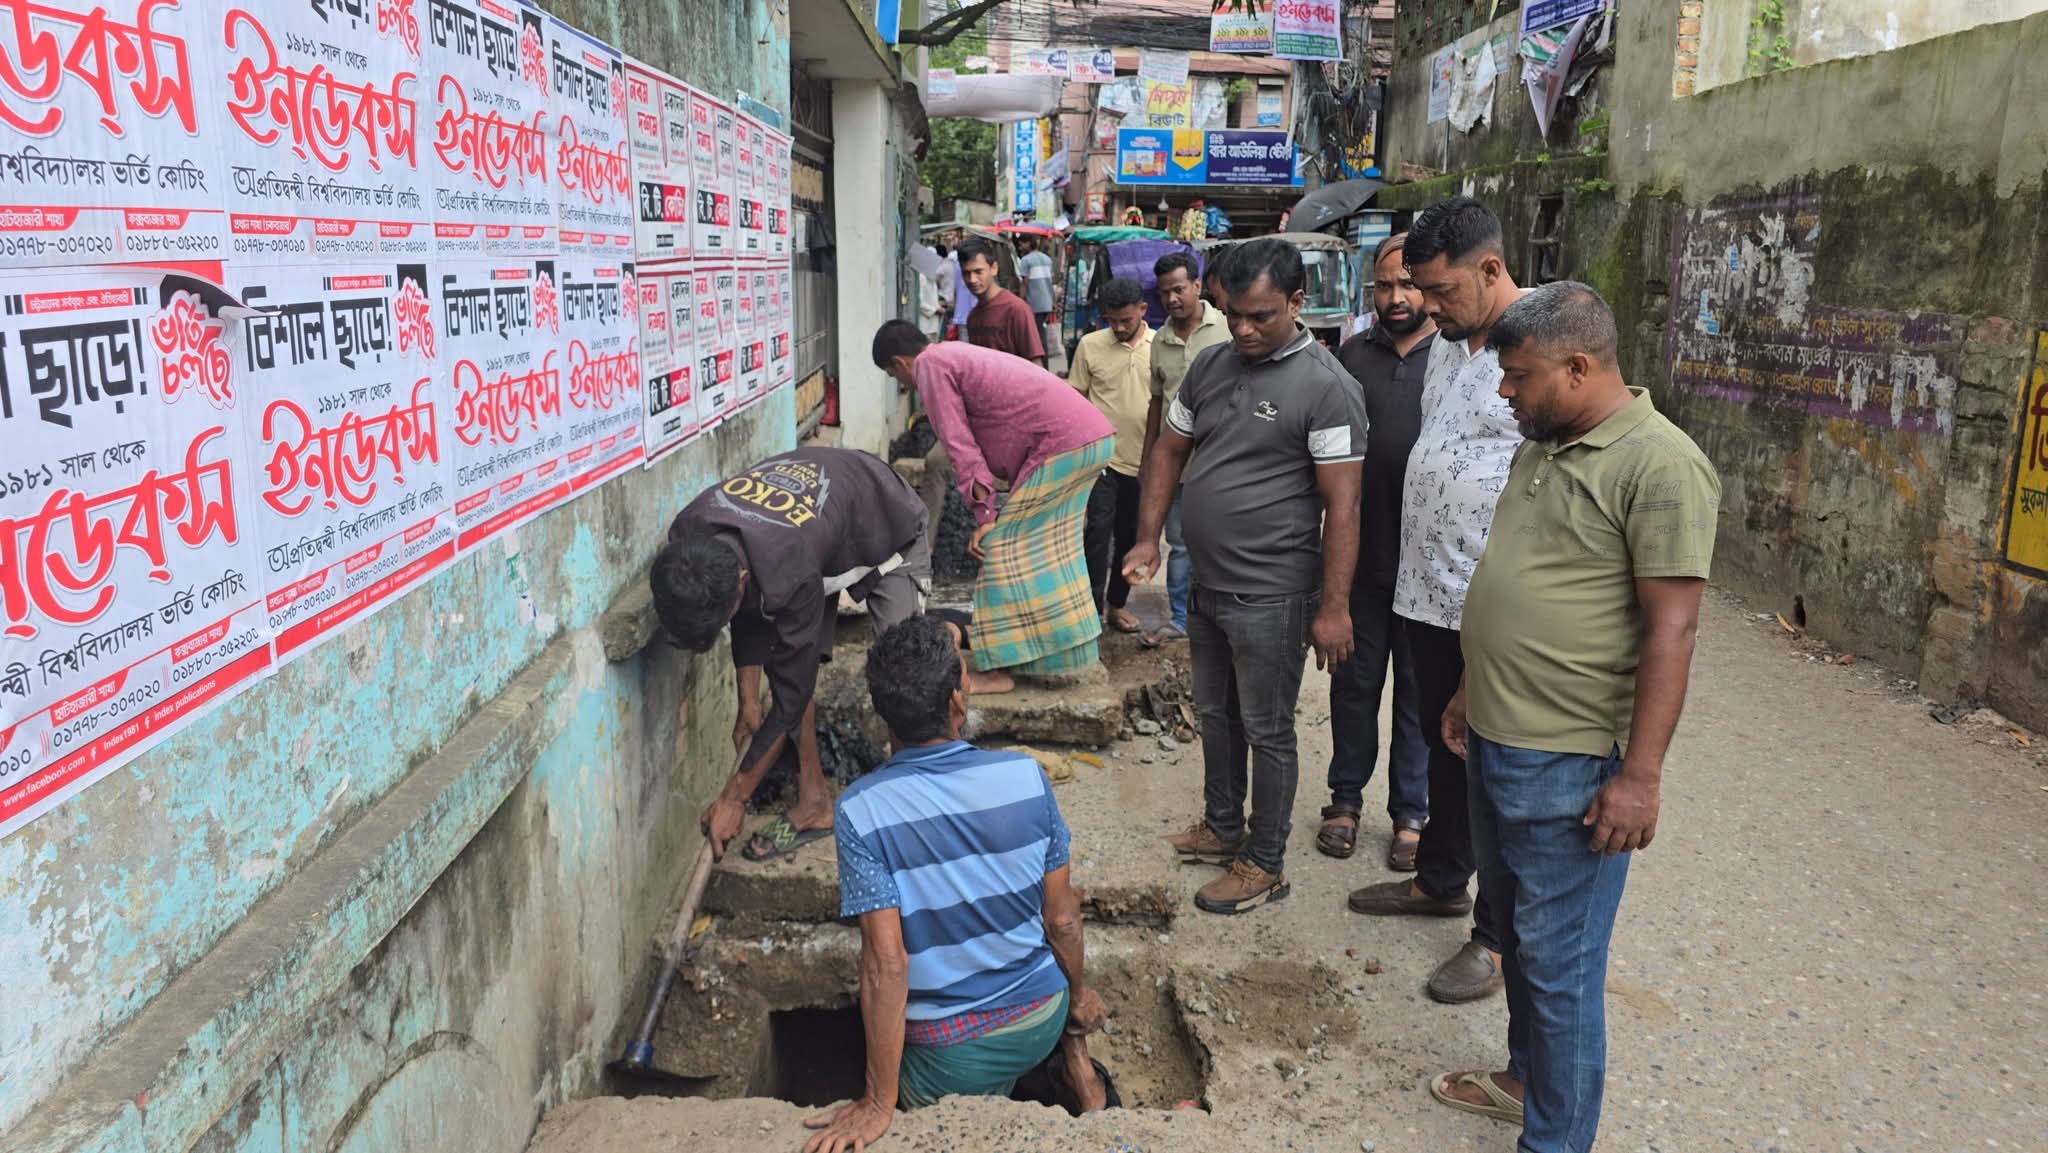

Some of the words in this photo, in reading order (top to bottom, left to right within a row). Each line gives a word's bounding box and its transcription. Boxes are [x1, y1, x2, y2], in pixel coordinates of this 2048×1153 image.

[287, 32, 316, 57] ১৯৮১
[320, 42, 341, 65] সাল
[345, 51, 368, 72] থেকে
[1097, 52, 1111, 63] 20
[0, 146, 105, 186] শ্ববিদ্যালয়
[112, 153, 151, 190] ভর্তি
[157, 159, 208, 193] কোচিং
[1228, 141, 1267, 160] আউলিয়া
[308, 175, 371, 206] বিশ্ববিদ্যালয়
[373, 183, 393, 207] ভর্তি
[397, 186, 421, 211] কোচিং
[152, 298, 206, 351] ভর্তি
[330, 297, 392, 370] ছাড়ে!
[443, 275, 492, 338] বিশাল
[494, 285, 531, 340] ছাড়ে!
[20, 318, 148, 428] ছাড়ে!
[163, 326, 232, 401] চলছে
[319, 397, 346, 413] ১৯৮১
[350, 388, 367, 405] সাল
[370, 382, 392, 400] থেকে
[0, 463, 54, 498] ১৯৮১
[59, 451, 96, 478] সাল
[103, 440, 146, 470] থেকে
[339, 505, 396, 544] বিশ্ববিদ্যালয়
[400, 488, 417, 515] ভর্তি
[420, 482, 443, 509] কোচিং
[722, 477, 817, 527] ECKO
[39, 613, 154, 684] বিশ্ববিদ্যালয়
[159, 585, 195, 624] ভর্তি
[202, 569, 247, 609] কোচিং
[173, 628, 259, 682] ০১৮৮০-৩৫২২০০
[54, 680, 160, 747] ০১৭৭৮-৩০৭০২০
[4, 756, 85, 807] www.facebook.com
